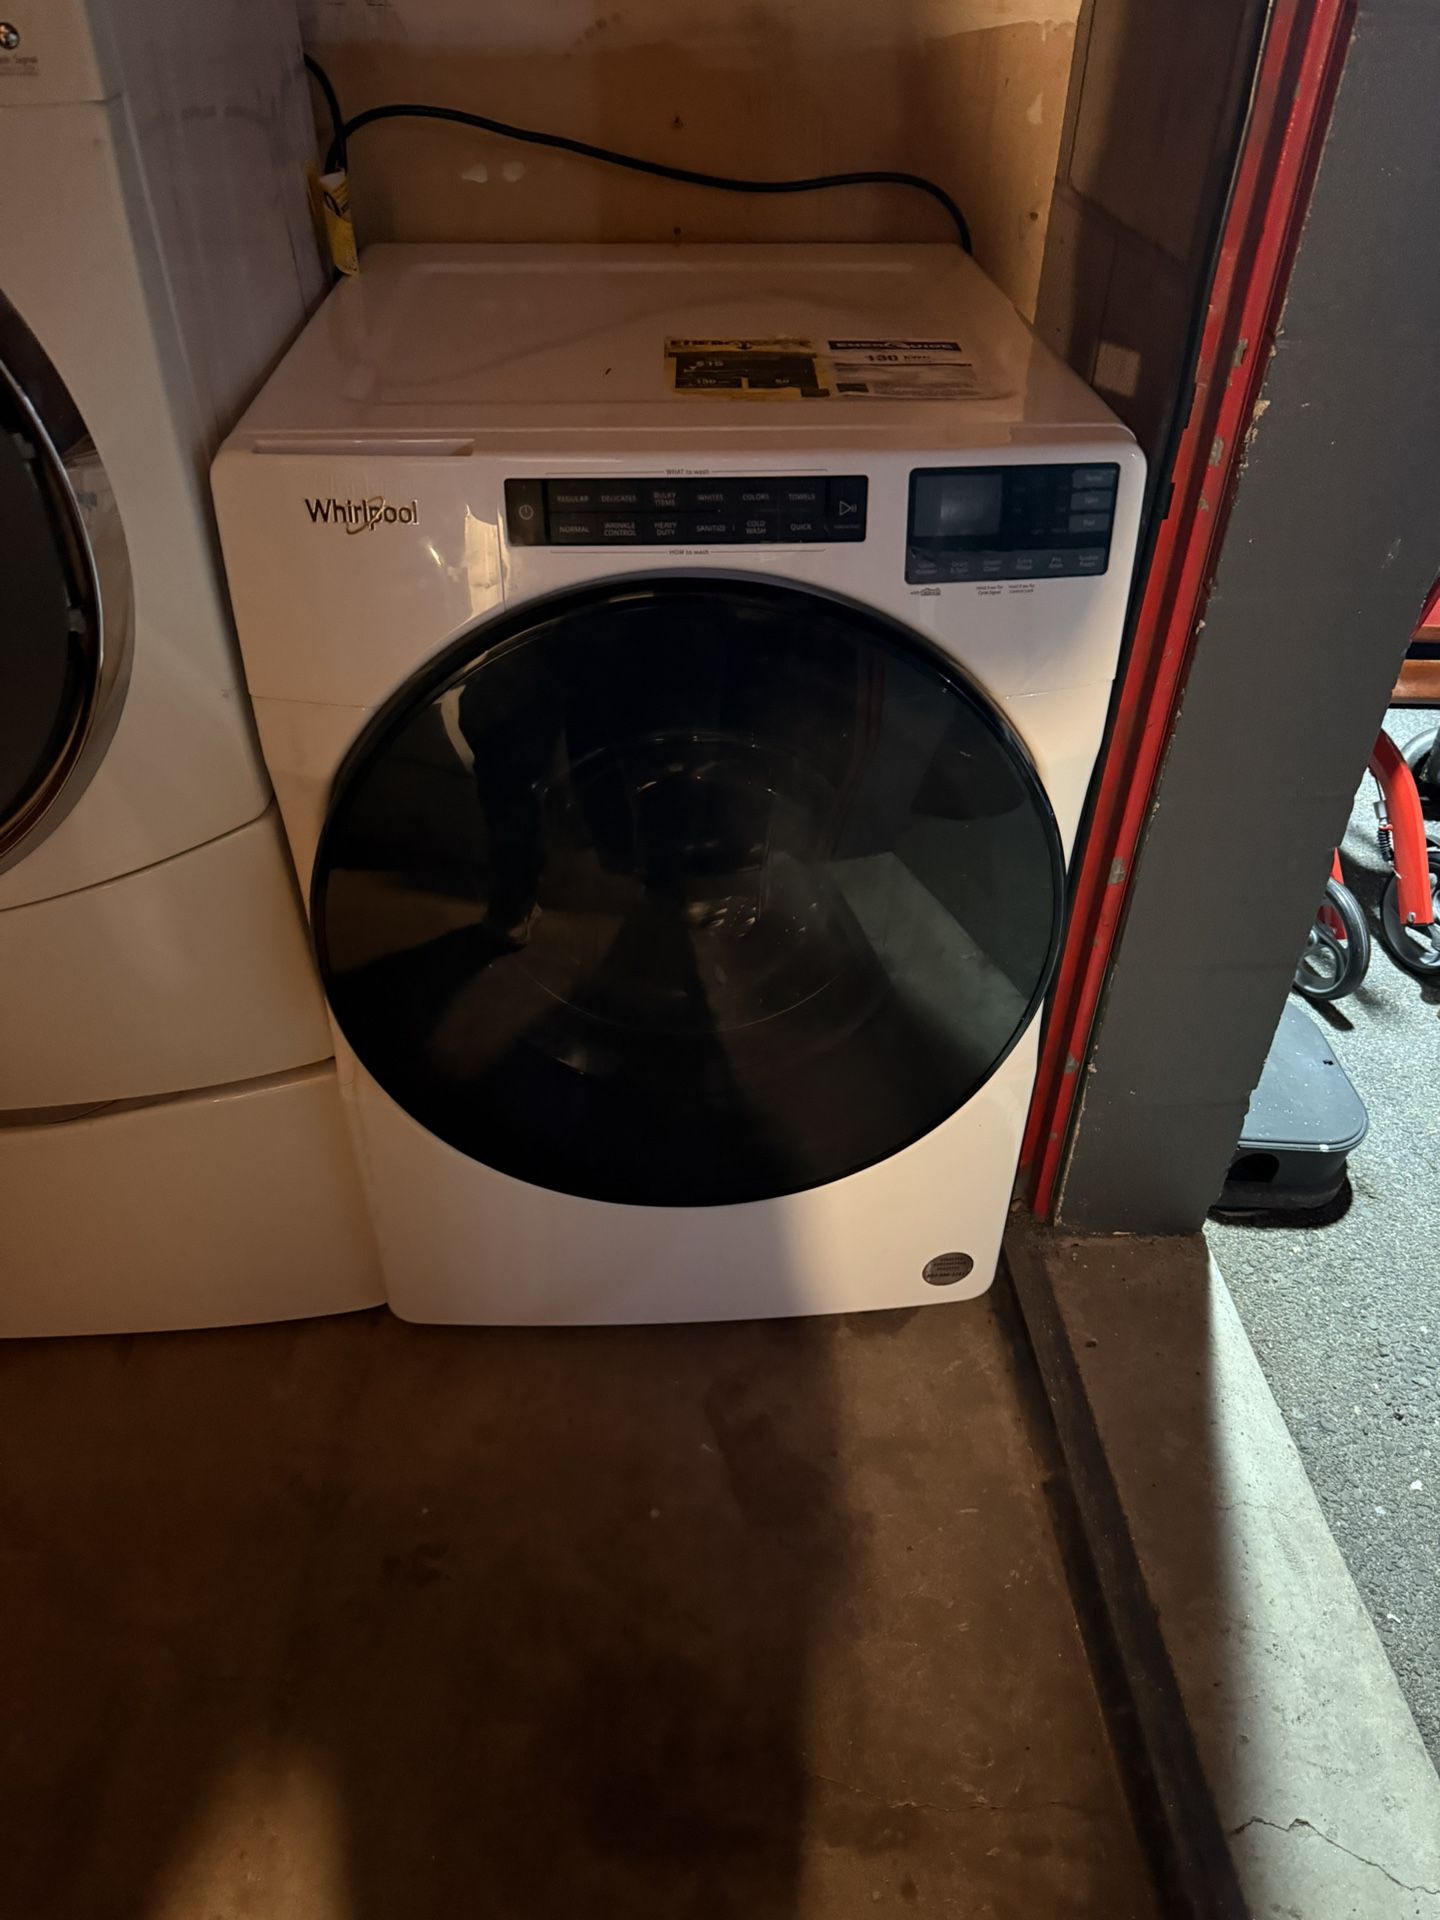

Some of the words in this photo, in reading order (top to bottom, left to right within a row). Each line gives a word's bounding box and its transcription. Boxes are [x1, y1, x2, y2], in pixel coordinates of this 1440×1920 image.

[865, 354, 898, 362] 130
[665, 468, 685, 476] WHAT
[693, 468, 710, 476] wash
[556, 494, 590, 503] REGULAR
[600, 493, 638, 503] DELICATES
[653, 490, 678, 499] BULKY
[696, 493, 725, 502] WHITES
[741, 493, 770, 501] COLORS
[788, 492, 817, 501] TOWELS
[655, 498, 677, 507] ITEMS
[304, 498, 418, 532] Whirlpool
[604, 521, 637, 529] WRINKLE
[653, 521, 679, 529] HEAVY
[746, 519, 767, 528] COLD
[789, 523, 813, 532] QUICK
[559, 525, 590, 534] NORMAL
[603, 529, 638, 537] CONTROL
[656, 529, 677, 537] DUTY
[695, 524, 727, 533] SANITIZE
[745, 527, 767, 535] WASH
